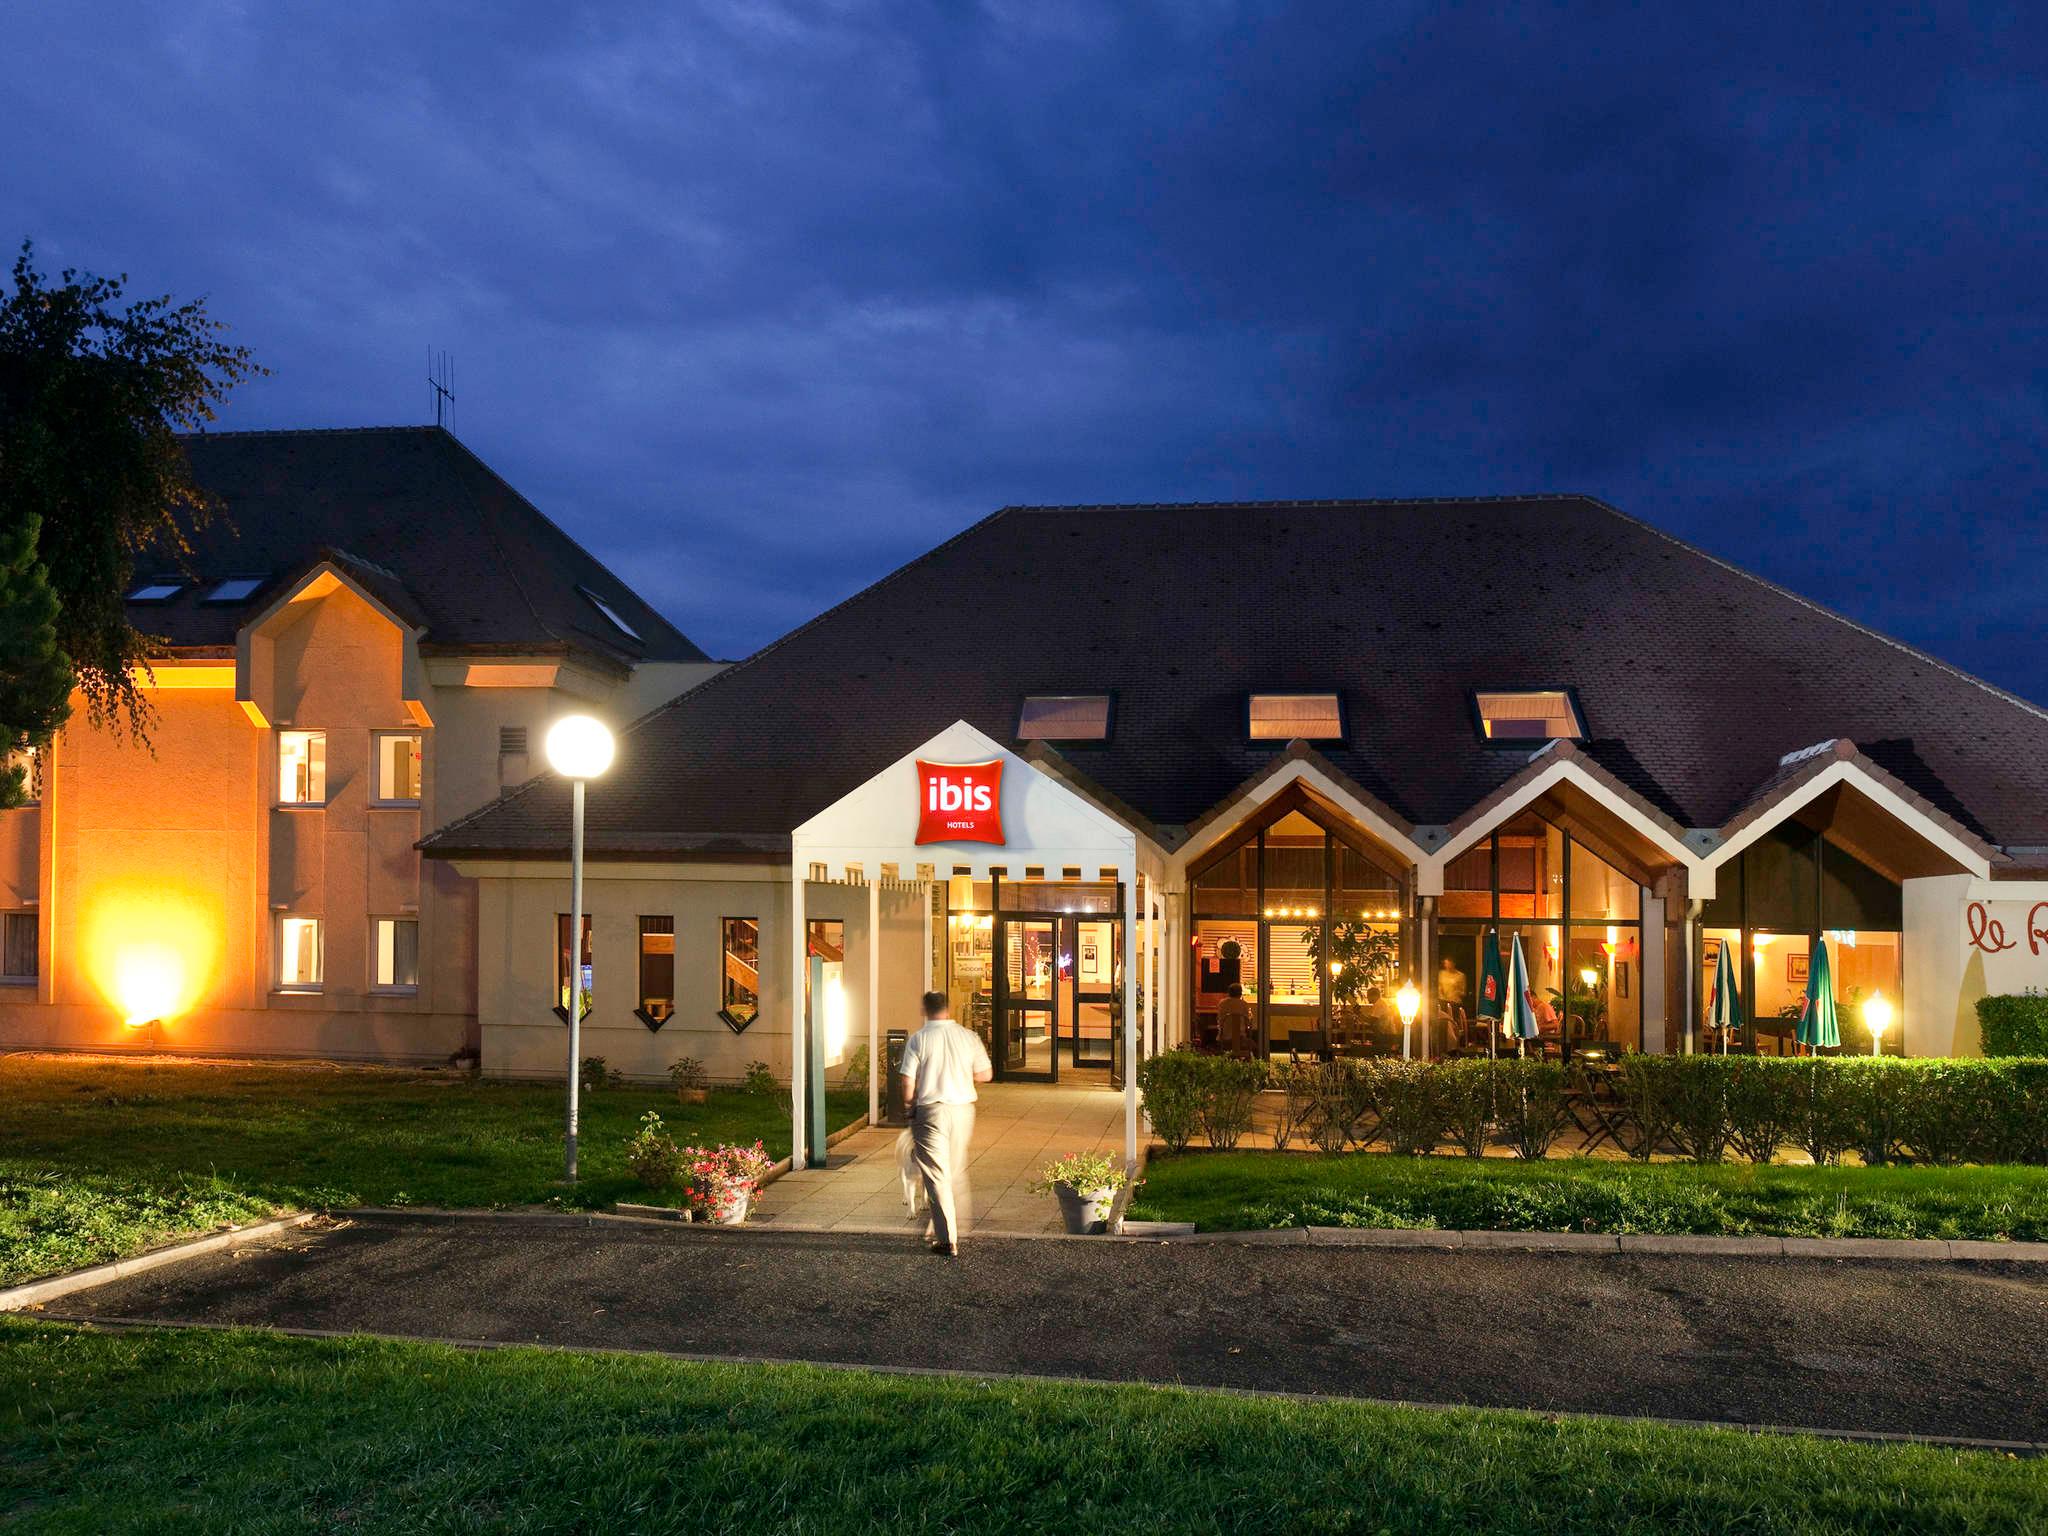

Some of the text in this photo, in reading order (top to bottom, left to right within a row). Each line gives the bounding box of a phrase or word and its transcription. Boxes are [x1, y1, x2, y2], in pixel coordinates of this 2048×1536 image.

[929, 777, 992, 811] ibis
[947, 821, 975, 829] HOTELS
[1967, 902, 2017, 953] le
